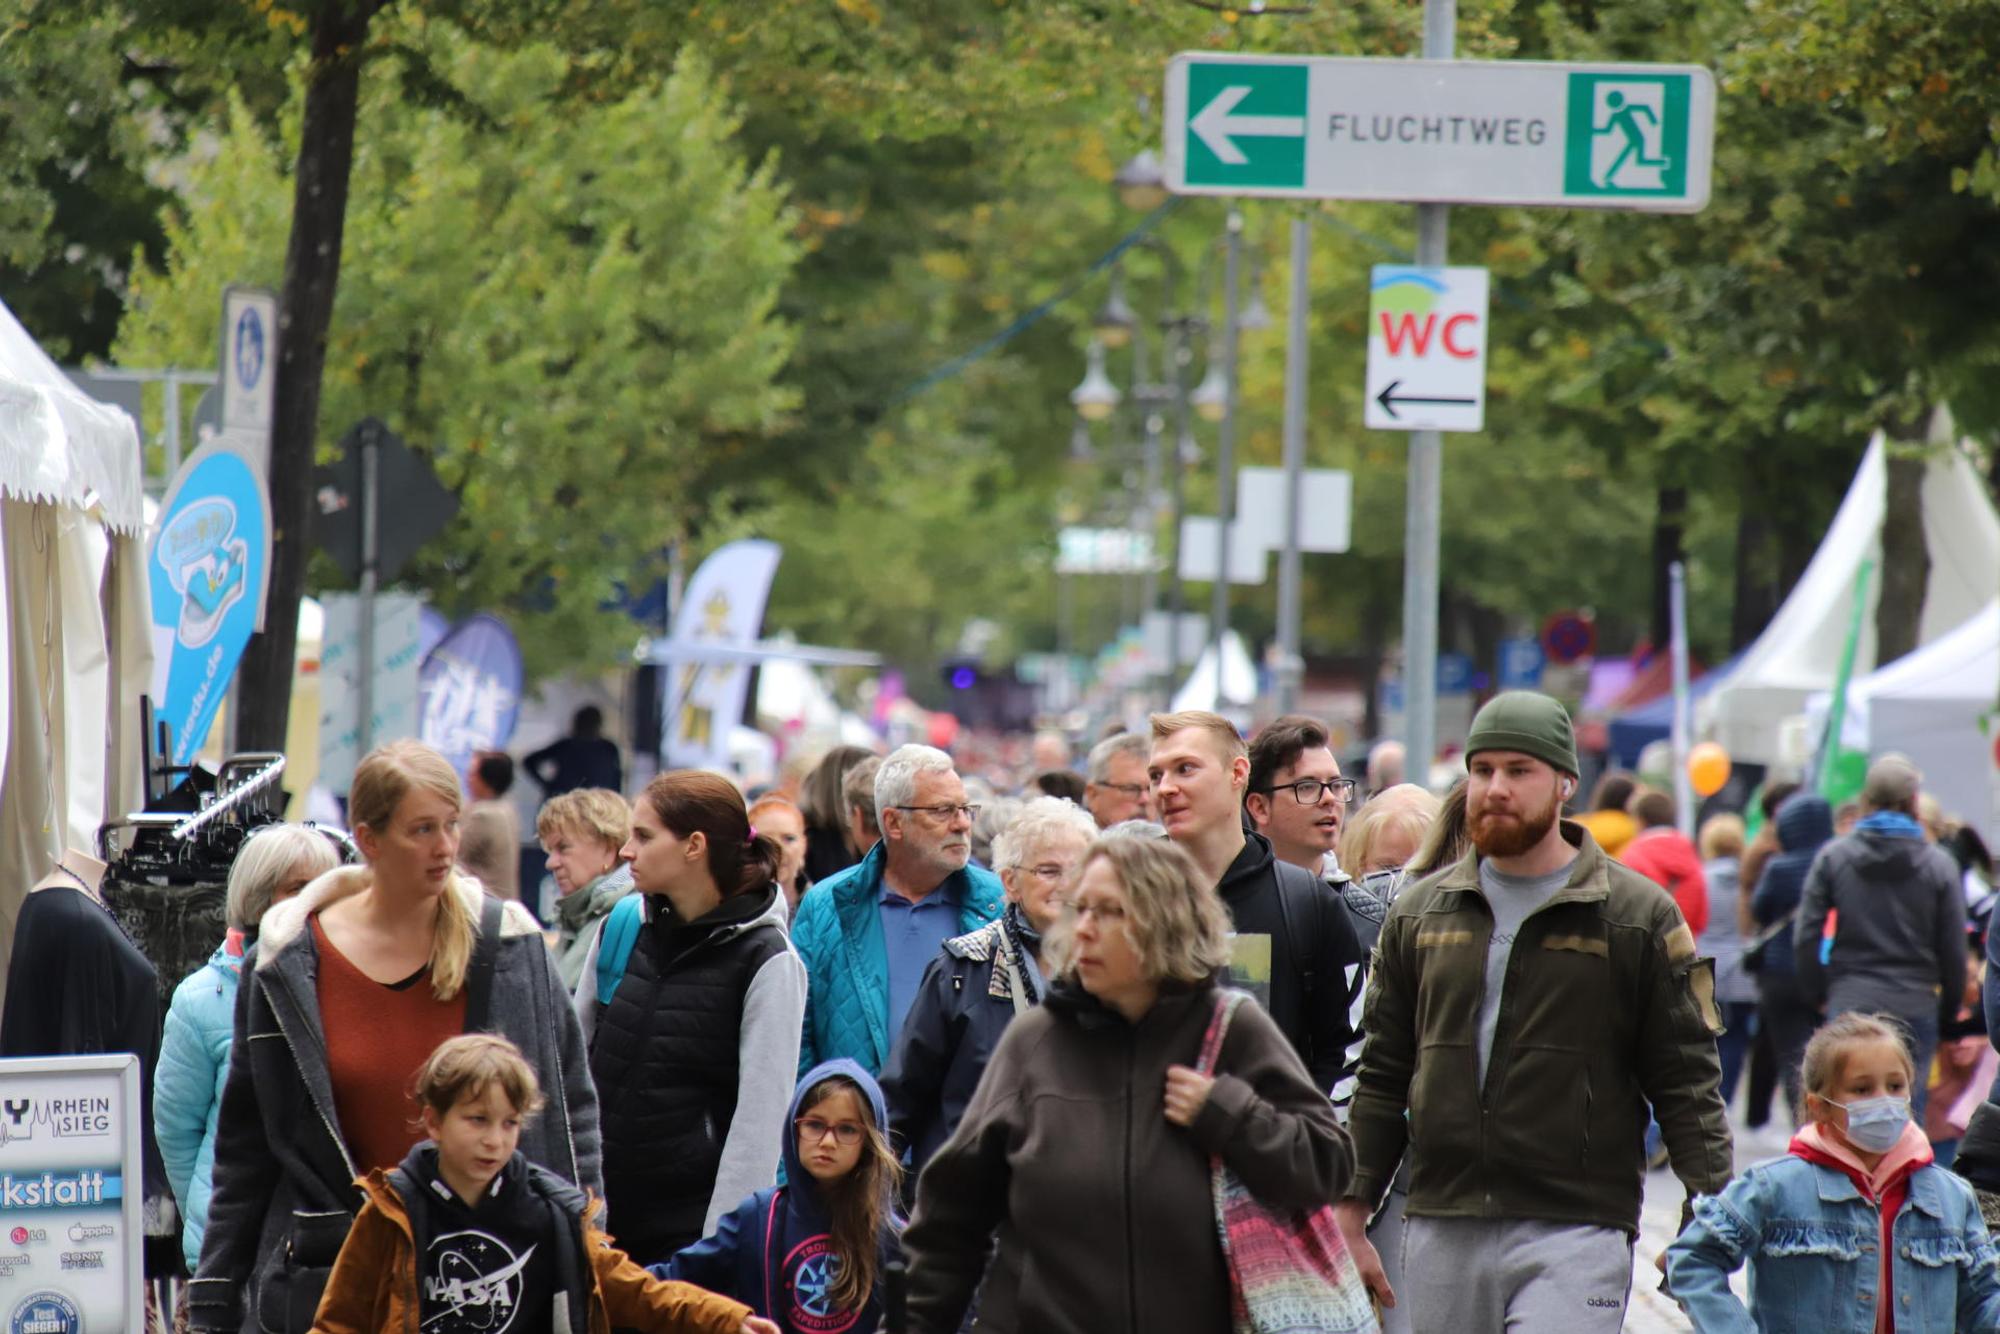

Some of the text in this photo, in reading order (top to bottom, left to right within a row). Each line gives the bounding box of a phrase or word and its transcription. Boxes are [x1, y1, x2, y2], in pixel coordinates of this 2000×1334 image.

[1328, 113, 1547, 147] FLUCHTWEG
[1378, 311, 1480, 361] WC
[53, 1098, 109, 1115] RHEIN
[63, 1115, 109, 1132] SIEG
[0, 1171, 103, 1207] kstatt
[30, 1229, 46, 1241] LG
[424, 1276, 513, 1307] NASA
